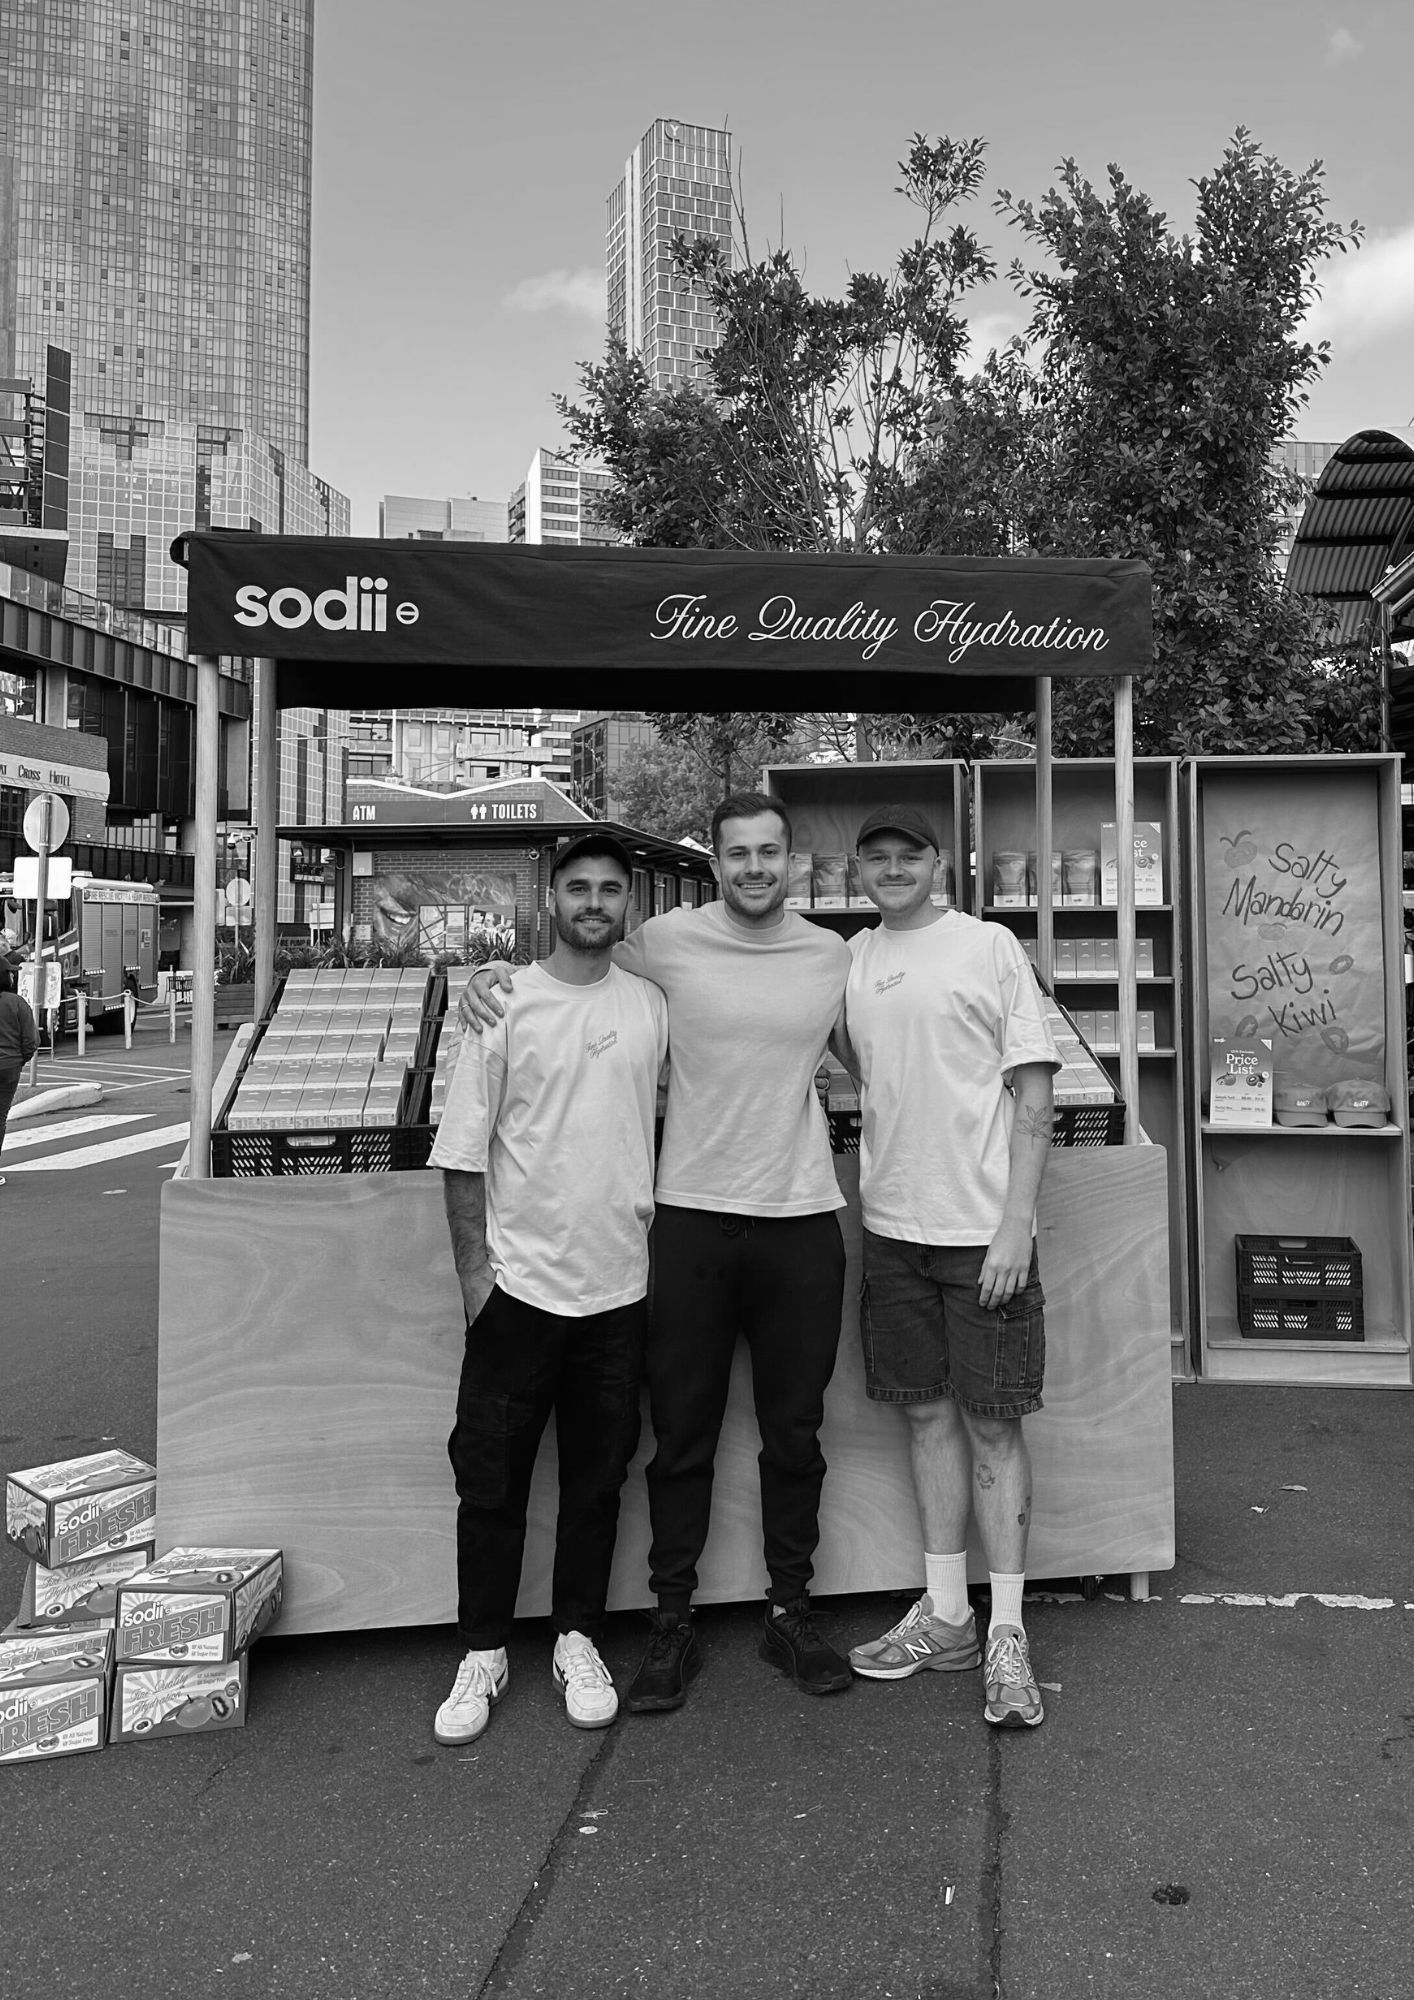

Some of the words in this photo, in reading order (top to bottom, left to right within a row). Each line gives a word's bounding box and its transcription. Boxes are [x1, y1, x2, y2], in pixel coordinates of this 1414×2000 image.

[233, 575, 389, 633] sodii
[649, 593, 739, 640] Fine
[747, 595, 898, 661] Quality
[913, 599, 1110, 664] Hydration
[18, 764, 41, 781] CROSS
[352, 805, 376, 821] ATM
[491, 803, 537, 820] TOILETS
[1268, 843, 1347, 899] Salty
[1222, 875, 1344, 937] Mandarin
[1231, 951, 1313, 1001] Salty
[1267, 989, 1337, 1038] Kiwi
[1226, 1053, 1259, 1065] Price
[1230, 1063, 1255, 1075] List
[58, 1501, 101, 1535] sodii
[59, 1487, 156, 1561] FRESH
[122, 1604, 224, 1655] FRESH
[123, 1601, 164, 1627] sodii
[904, 1638, 932, 1660] N
[0, 1688, 98, 1751] RESH
